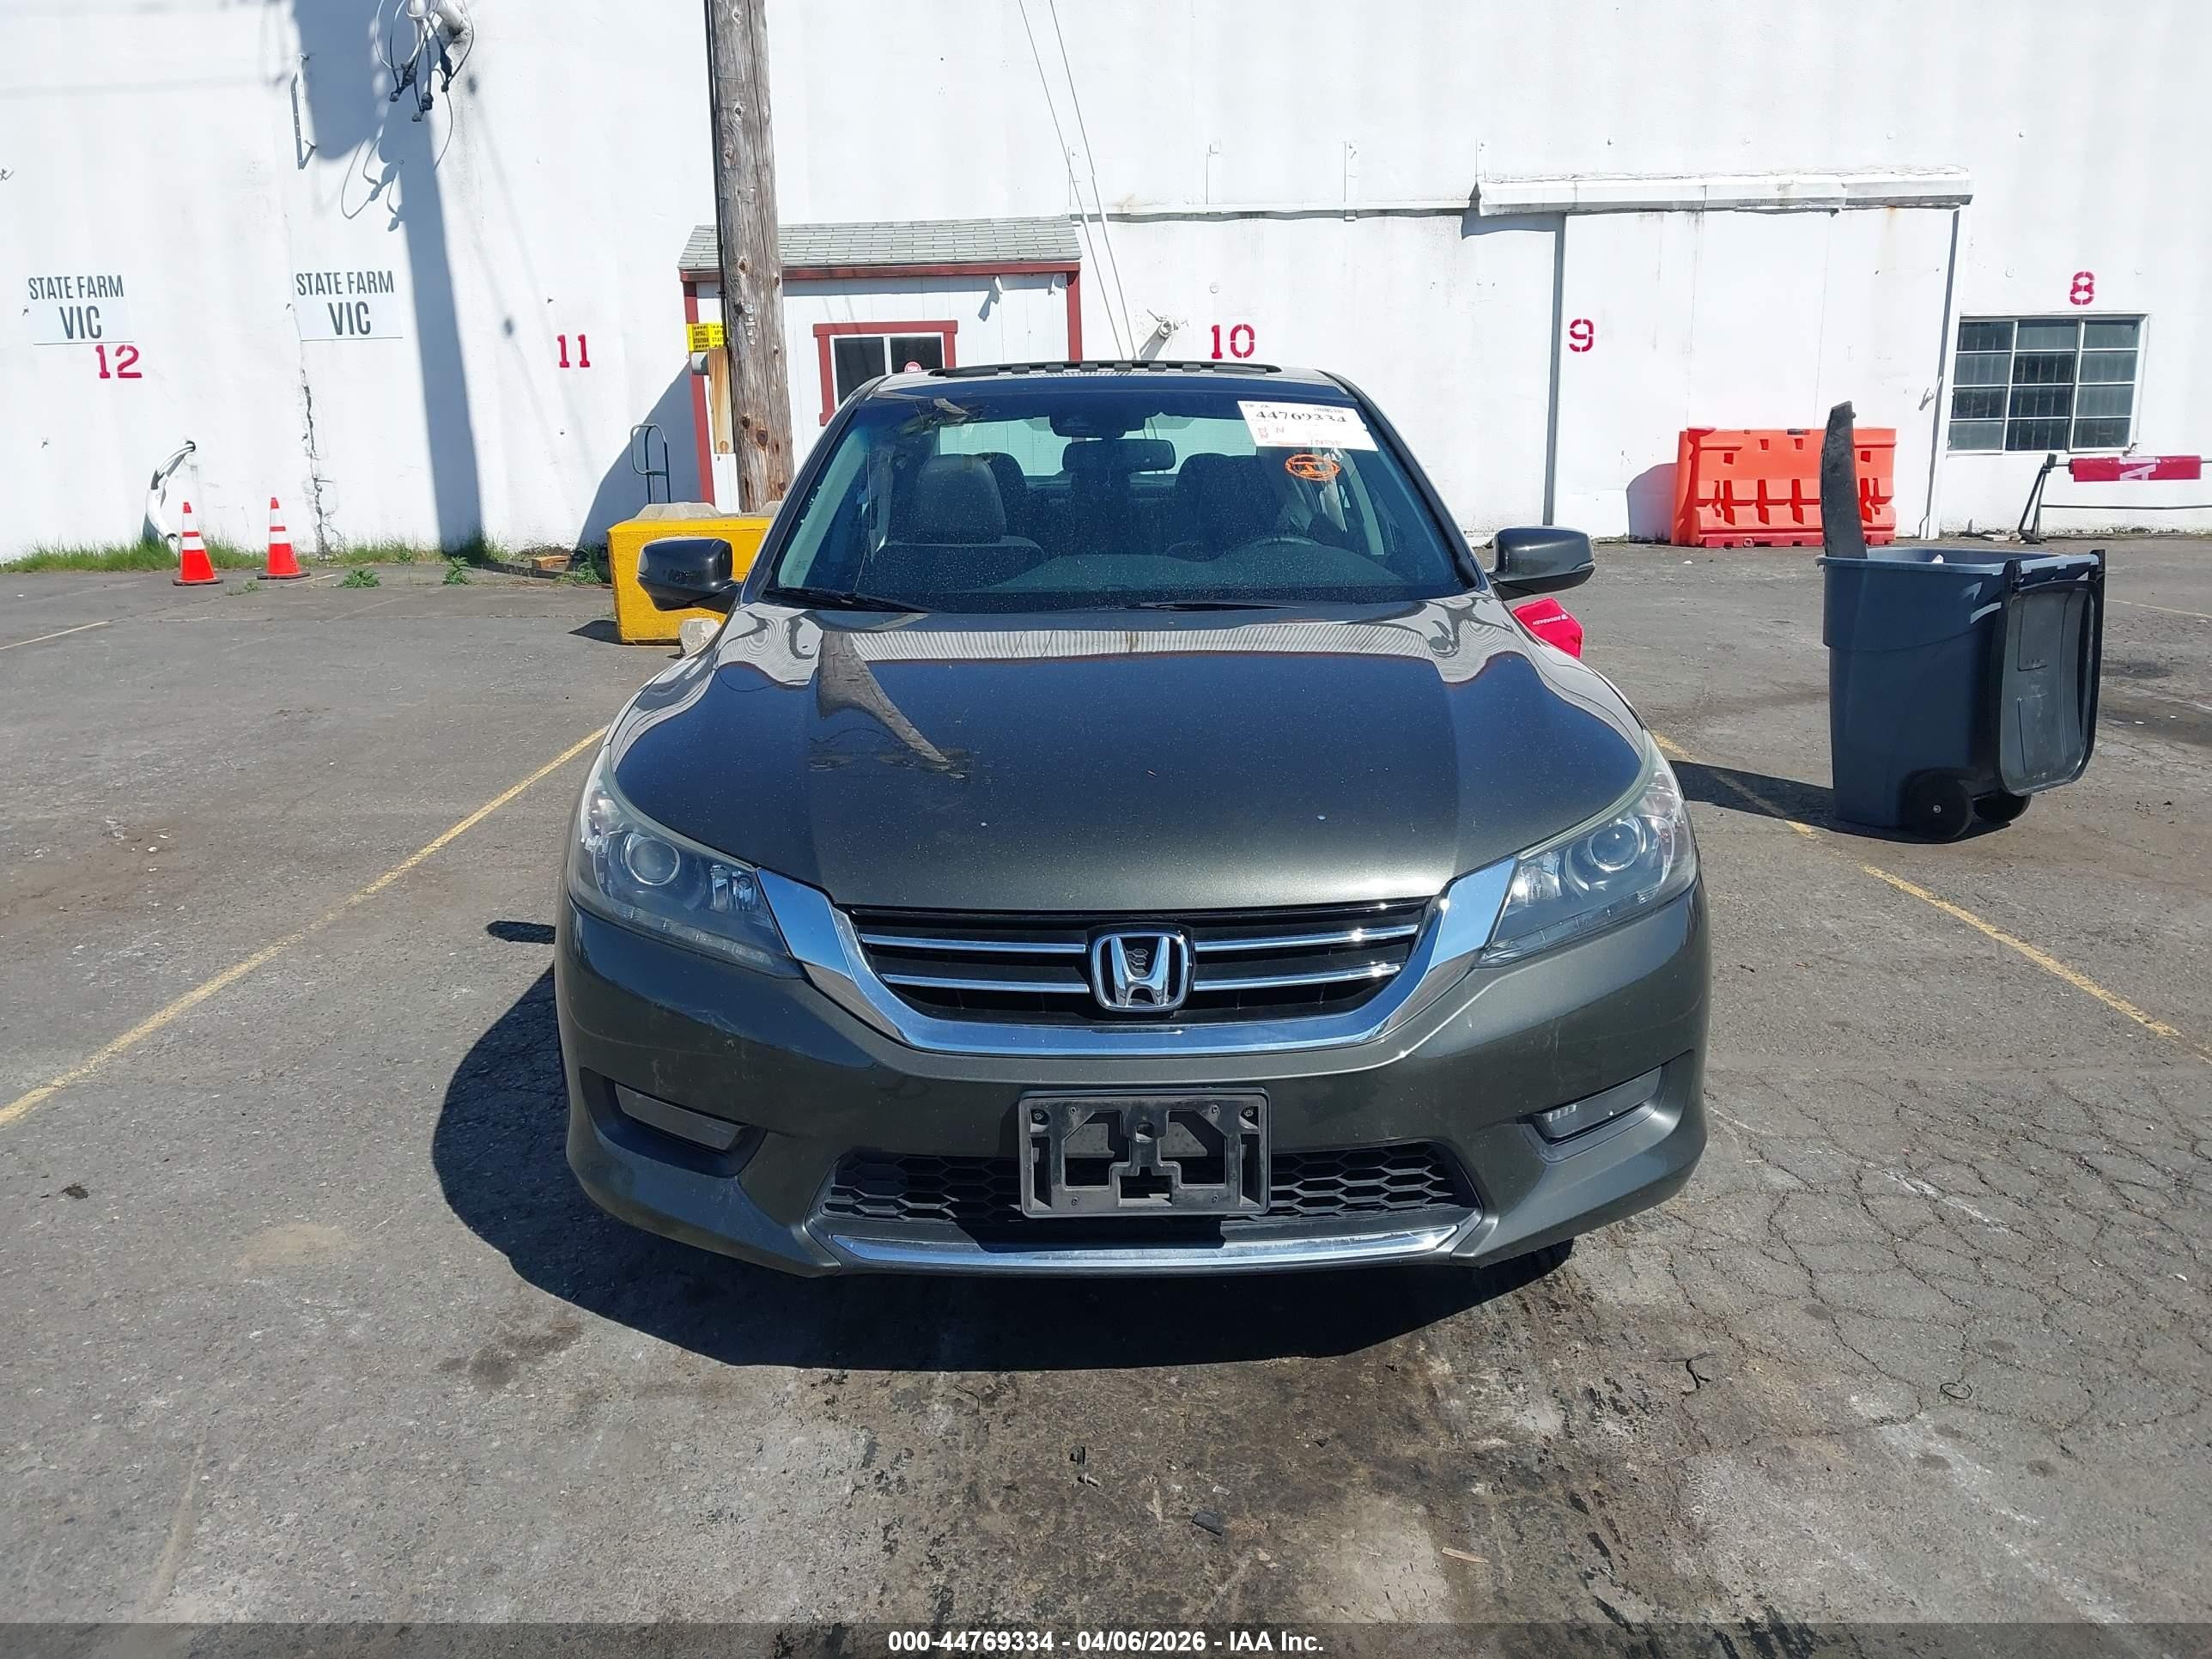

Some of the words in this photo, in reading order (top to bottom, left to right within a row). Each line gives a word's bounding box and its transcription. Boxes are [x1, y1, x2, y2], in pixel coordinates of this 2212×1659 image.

[28, 276, 74, 301] STATE
[77, 275, 124, 298] FARM
[296, 271, 343, 296] STATE
[347, 270, 394, 295] FARM
[2069, 271, 2094, 305] 8
[59, 305, 101, 340] VIC
[327, 301, 371, 336] VIC
[1570, 319, 1594, 352] 9
[557, 334, 590, 368] 11
[1212, 324, 1255, 359] 10
[95, 344, 143, 379] 12
